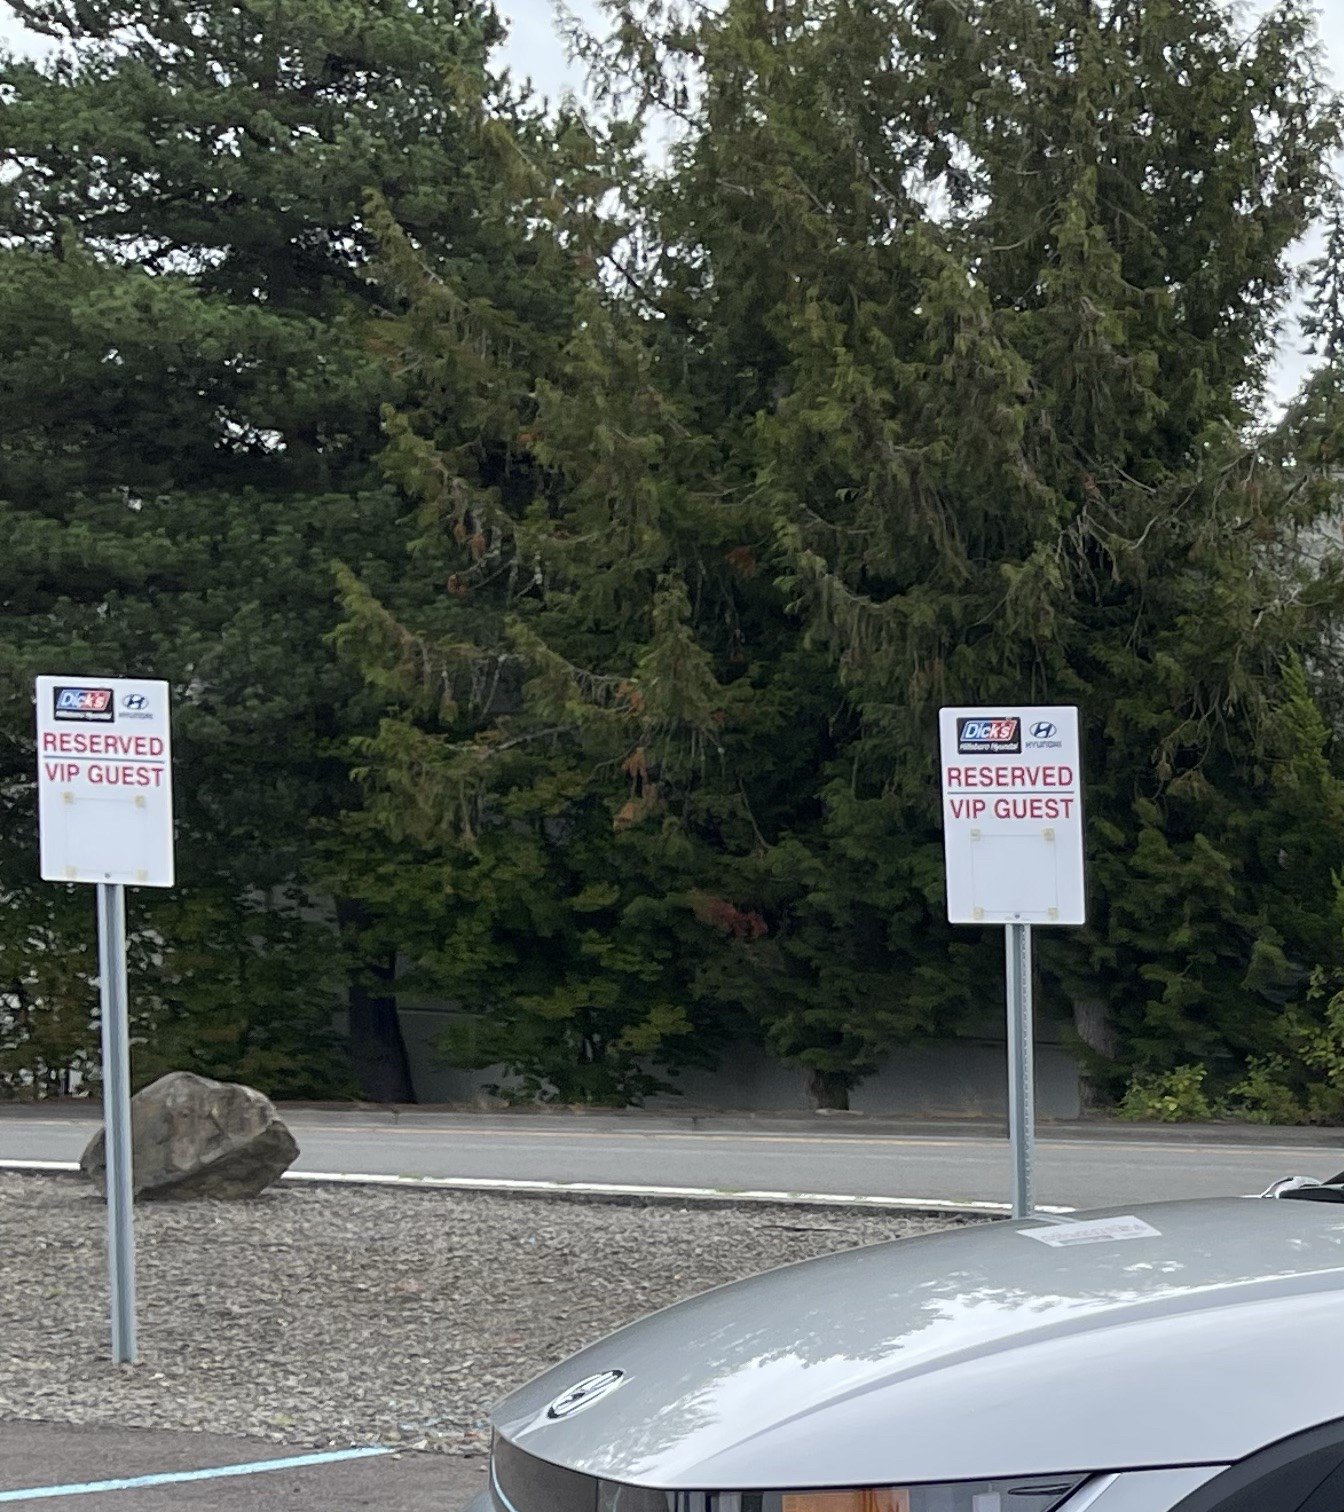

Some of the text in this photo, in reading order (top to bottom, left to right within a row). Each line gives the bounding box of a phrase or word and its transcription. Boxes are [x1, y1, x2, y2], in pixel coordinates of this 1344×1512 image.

[43, 732, 164, 757] RESERVED
[45, 762, 164, 787] VIP GUEST
[947, 766, 1074, 788] RESERVED
[950, 798, 1074, 820] VIP GUEST
